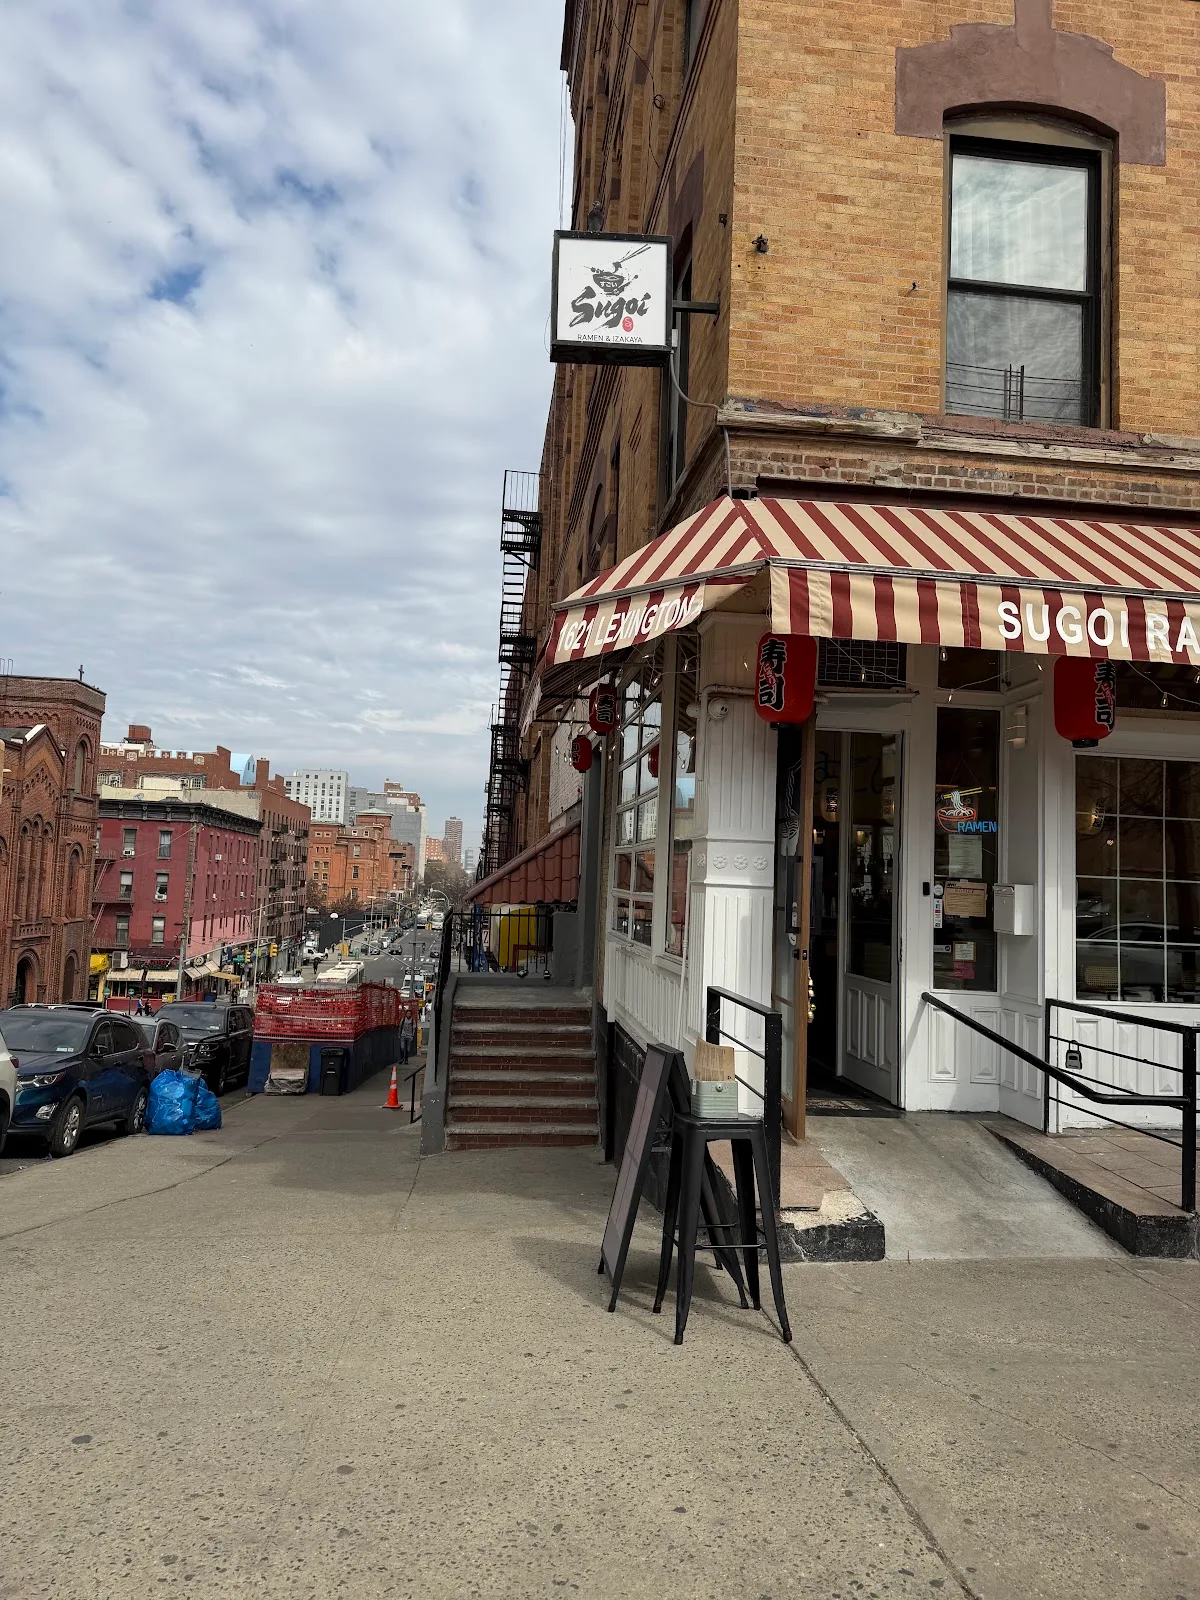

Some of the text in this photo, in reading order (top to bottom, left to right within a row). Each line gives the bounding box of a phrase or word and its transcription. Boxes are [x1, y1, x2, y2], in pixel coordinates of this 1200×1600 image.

[569, 285, 651, 331] Sugoi
[577, 334, 604, 342] RAMEN
[557, 616, 595, 652] 1621
[594, 595, 696, 646] LEXINGTON
[997, 601, 1130, 648] SUGOI
[957, 821, 998, 833] RAMEN
